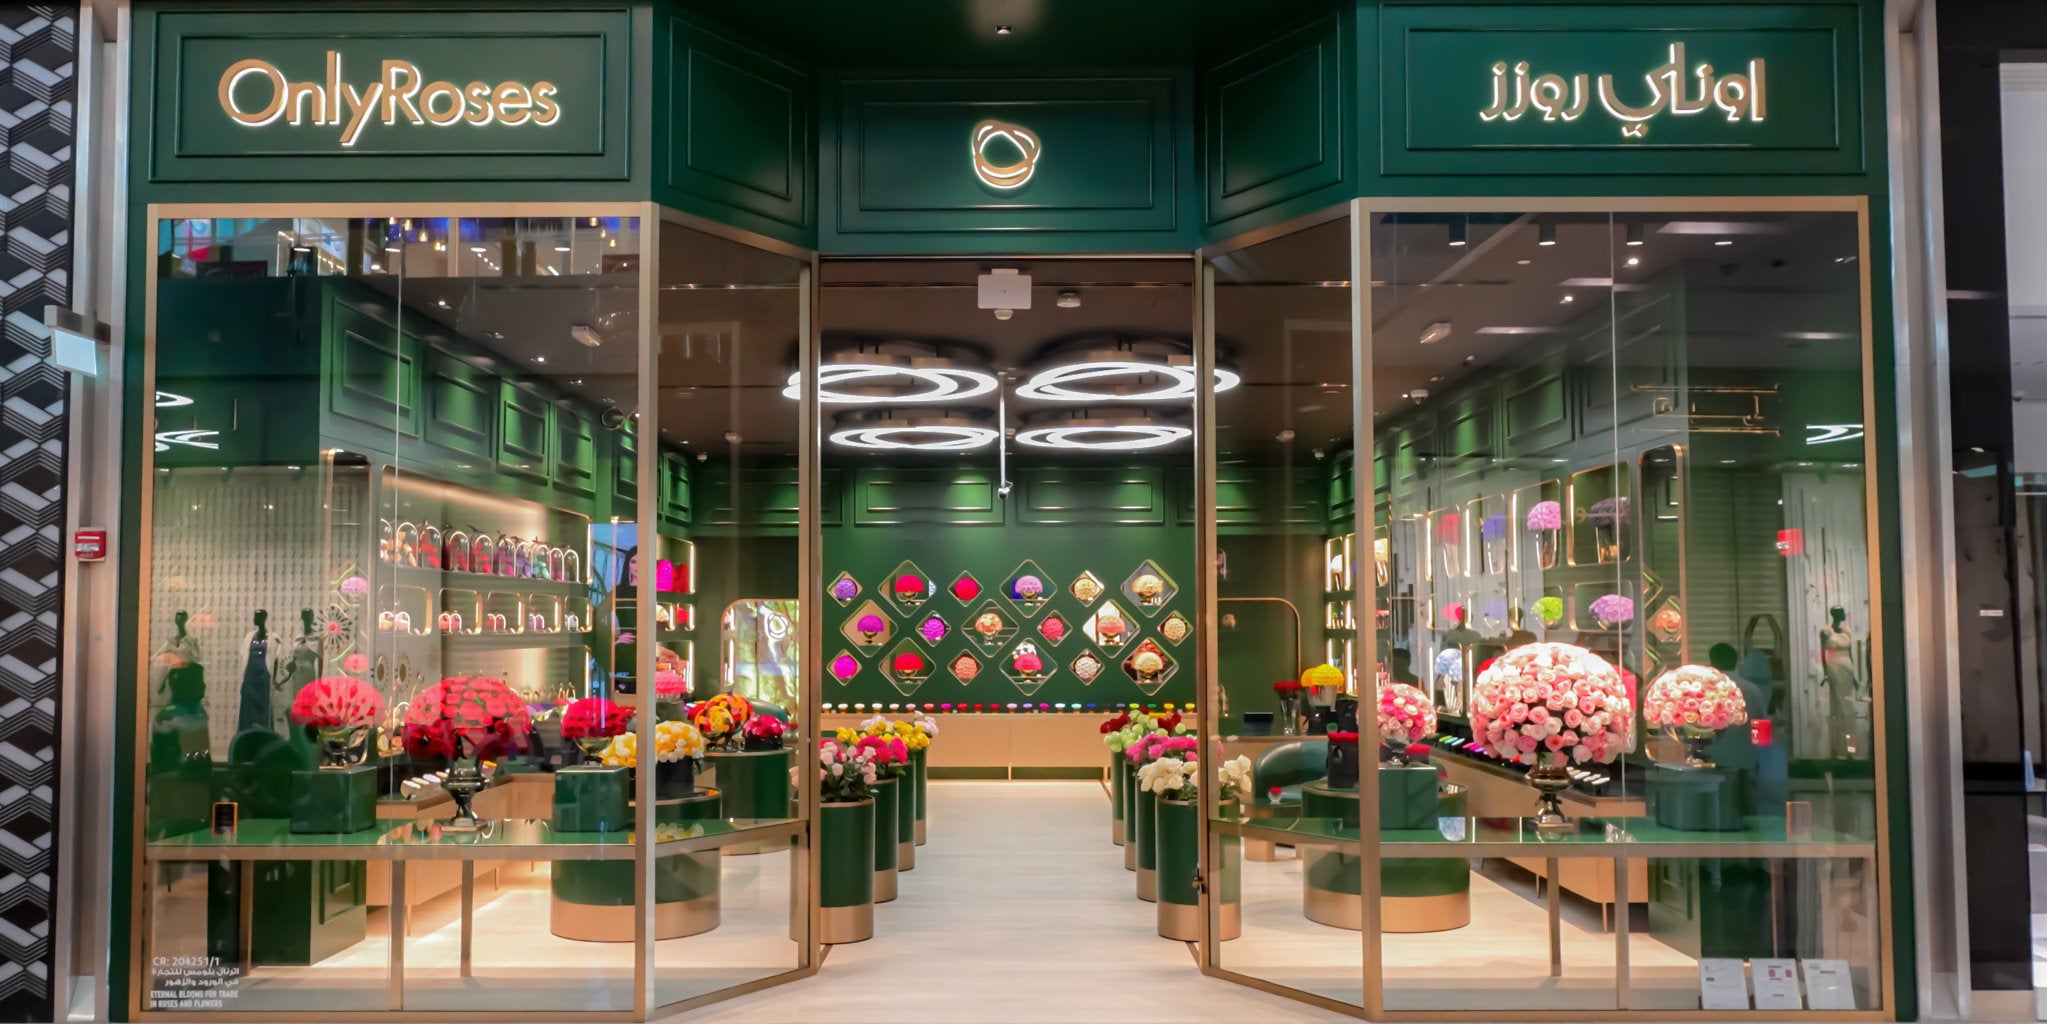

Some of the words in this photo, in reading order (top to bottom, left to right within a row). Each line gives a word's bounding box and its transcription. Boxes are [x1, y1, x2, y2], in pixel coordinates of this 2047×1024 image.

[1479, 60, 1589, 121] روزز
[1598, 41, 1767, 136] اونلي
[218, 50, 561, 146] OnlyRoses
[152, 957, 169, 966] CR:
[172, 957, 220, 967] 204251/1
[197, 978, 223, 987] الورود
[224, 978, 239, 988] في
[150, 990, 177, 999] ETERNAL
[178, 990, 204, 999] BLOOMS
[204, 990, 216, 999] FOR
[218, 990, 239, 999] TRADE
[149, 1000, 157, 1008] IN
[158, 1000, 178, 1008] ROSES
[179, 1000, 193, 1008] AND
[193, 1000, 223, 1008] FLOWERS
